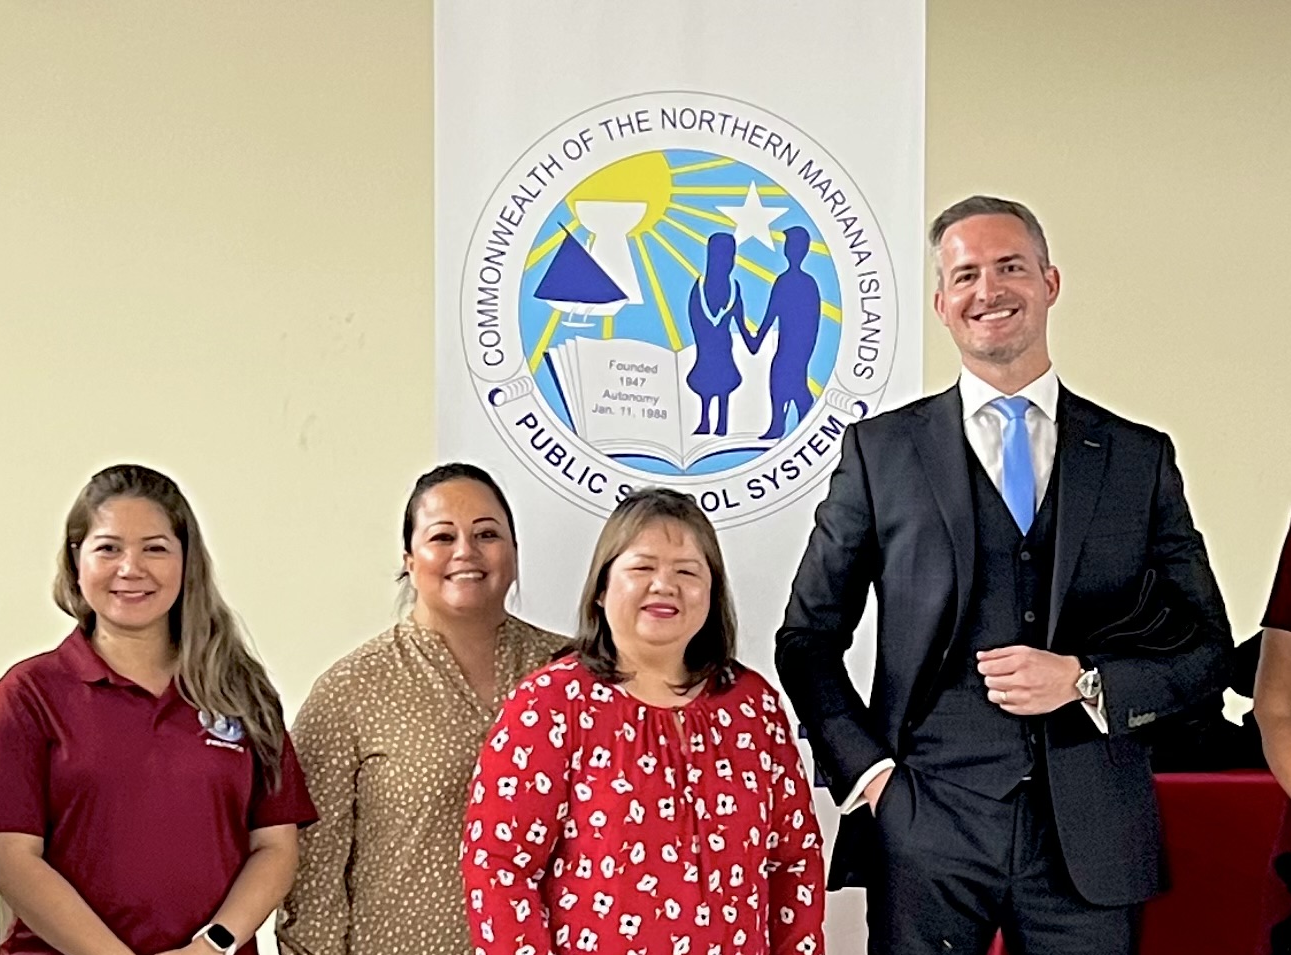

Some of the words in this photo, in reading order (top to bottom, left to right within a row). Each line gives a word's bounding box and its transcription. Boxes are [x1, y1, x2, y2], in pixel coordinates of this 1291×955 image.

[478, 153, 563, 367] COMMONWEALTH
[562, 127, 596, 162] OF
[598, 109, 653, 144] THE
[660, 107, 801, 167] NORTHERN
[797, 159, 871, 268] MARIANA
[852, 270, 883, 381] ISLANDS
[609, 360, 658, 374] Founded
[603, 389, 660, 406] Autonomy
[592, 404, 614, 414] Jan.
[515, 410, 610, 495] PUBLIC
[746, 413, 846, 500] SYSTEM
